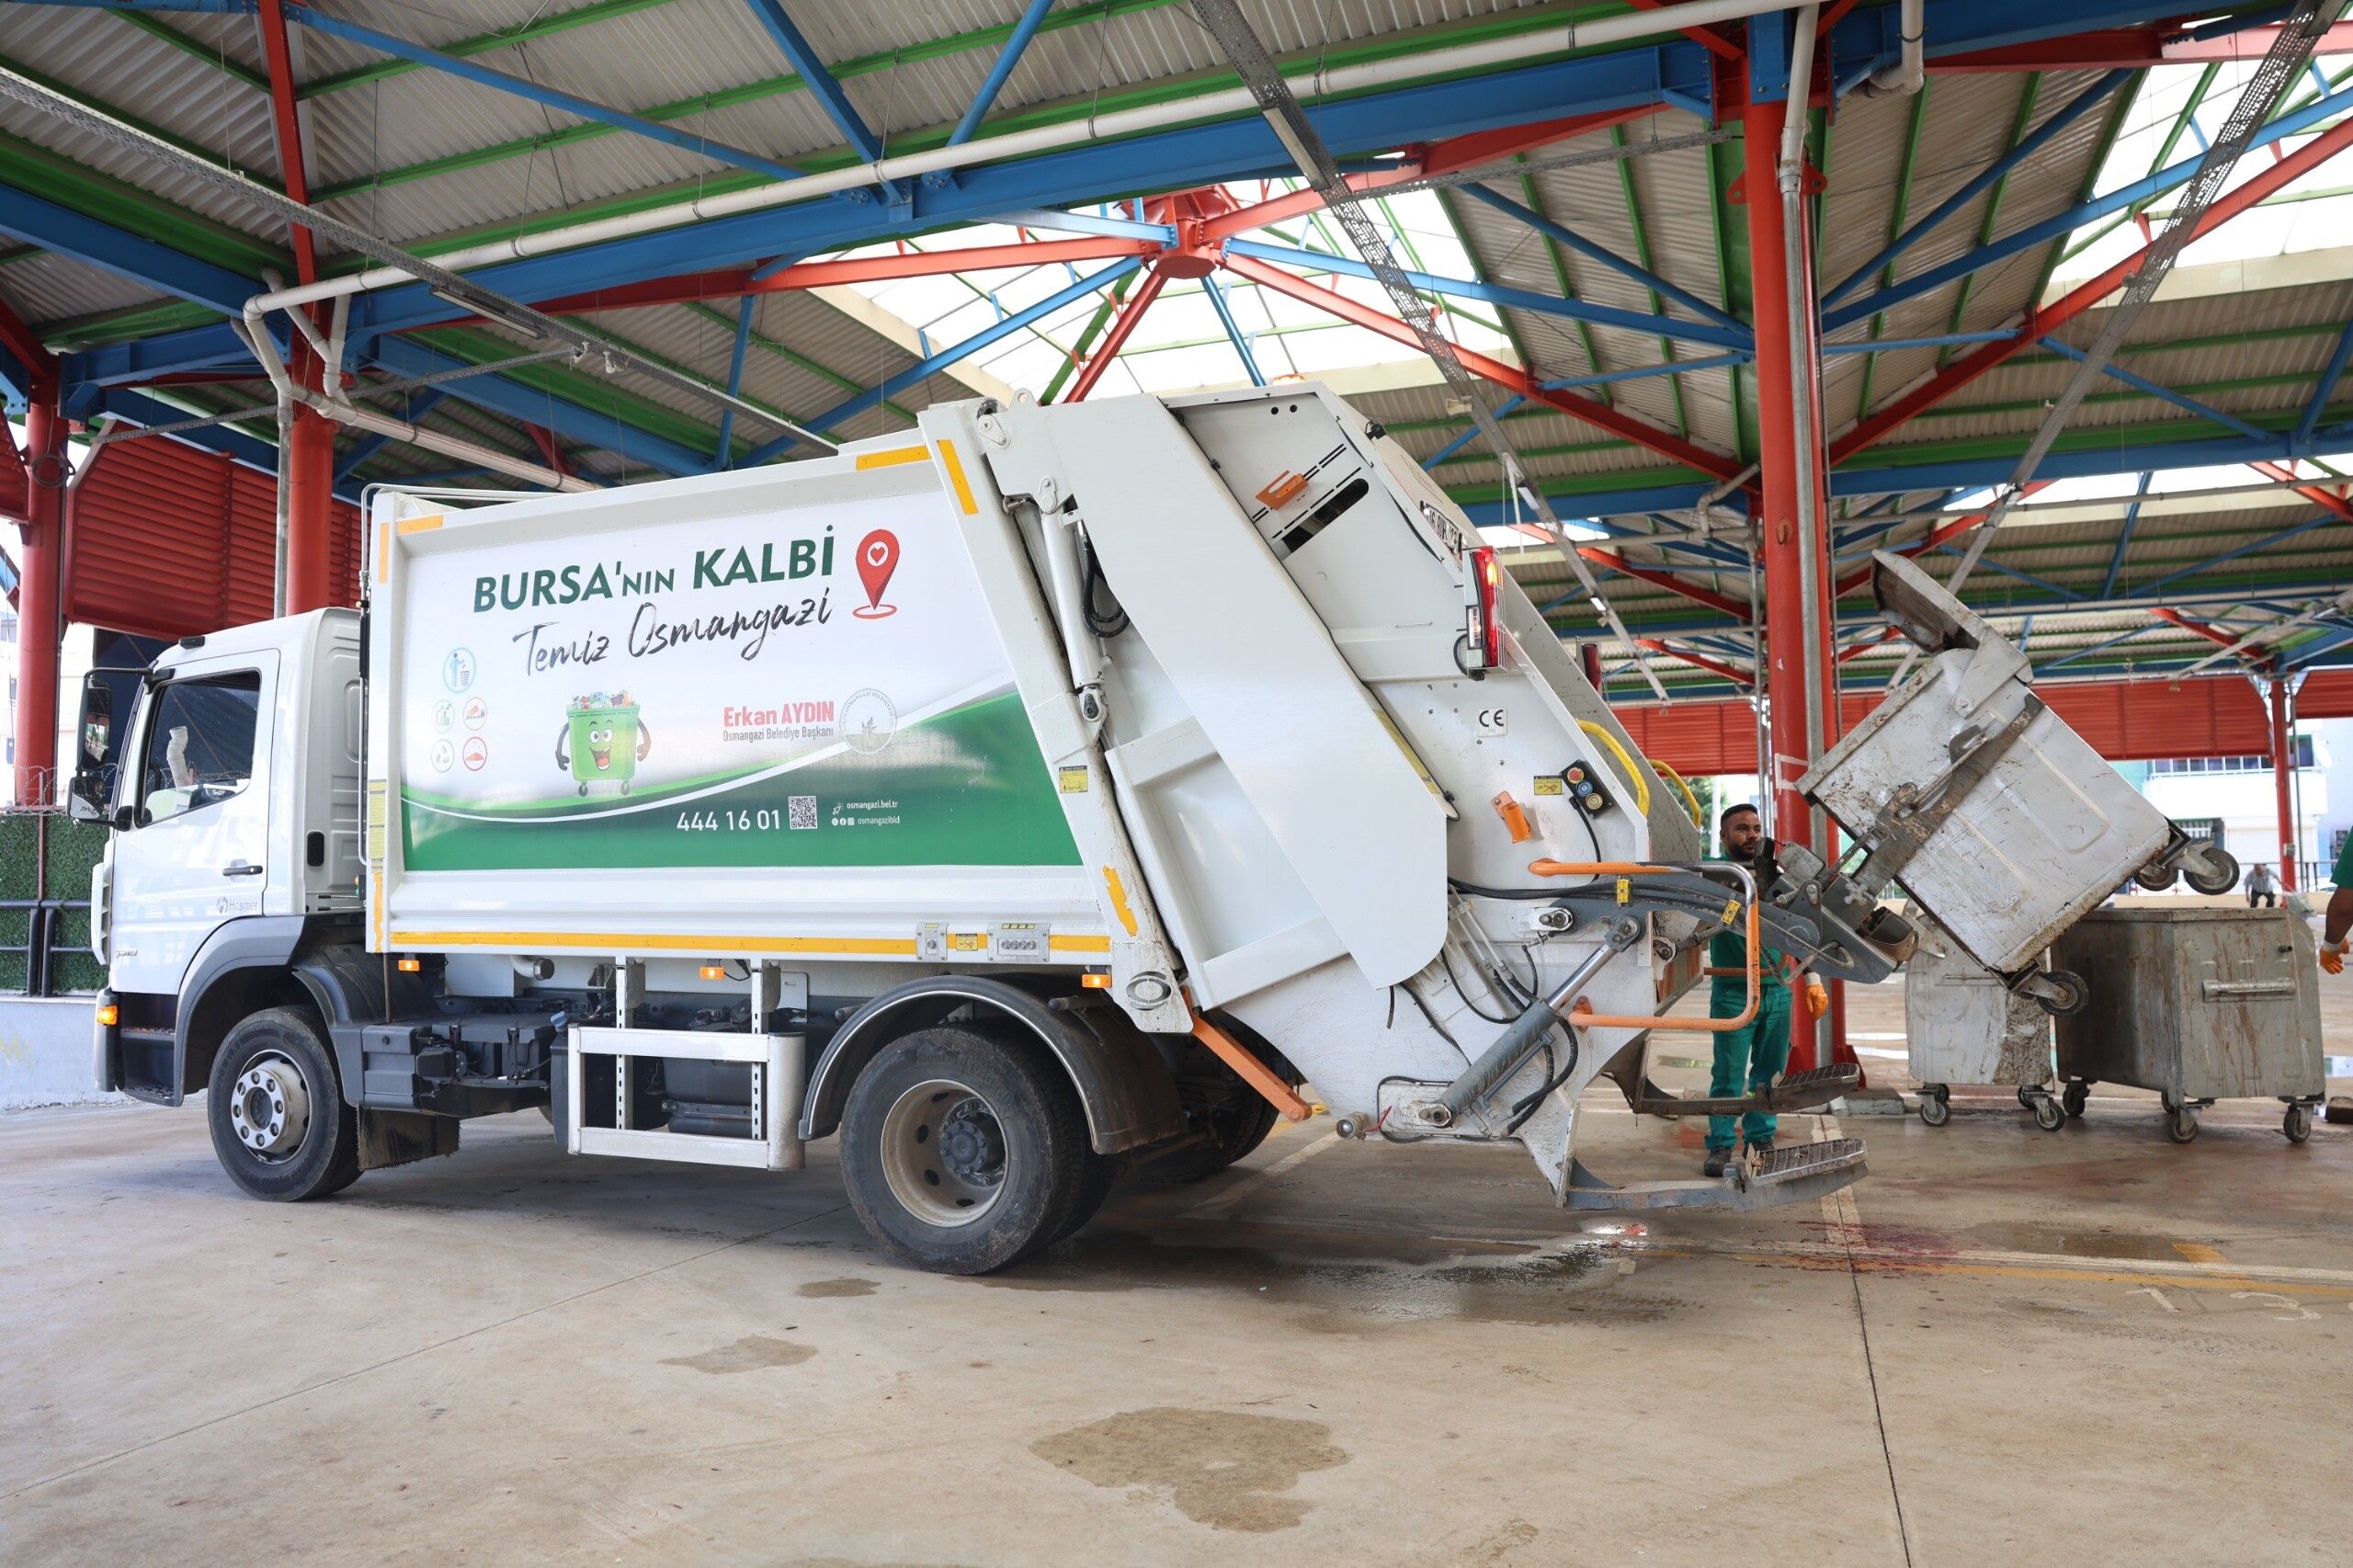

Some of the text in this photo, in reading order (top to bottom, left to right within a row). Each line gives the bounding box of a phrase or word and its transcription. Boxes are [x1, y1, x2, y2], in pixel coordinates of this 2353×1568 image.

[473, 524, 835, 613] BURSA'NIN KALBİ
[512, 587, 835, 676] Temiz Osmangazi
[723, 706, 778, 727] Erkan
[781, 700, 835, 724] AYDIN
[722, 725, 834, 743] Osmangazi Belediye Başkanı
[847, 800, 898, 810] osmangazi.bel.tr
[676, 810, 780, 832] 444 16 01
[858, 815, 901, 826] osmangazibld
[230, 900, 258, 911] Hasmer
